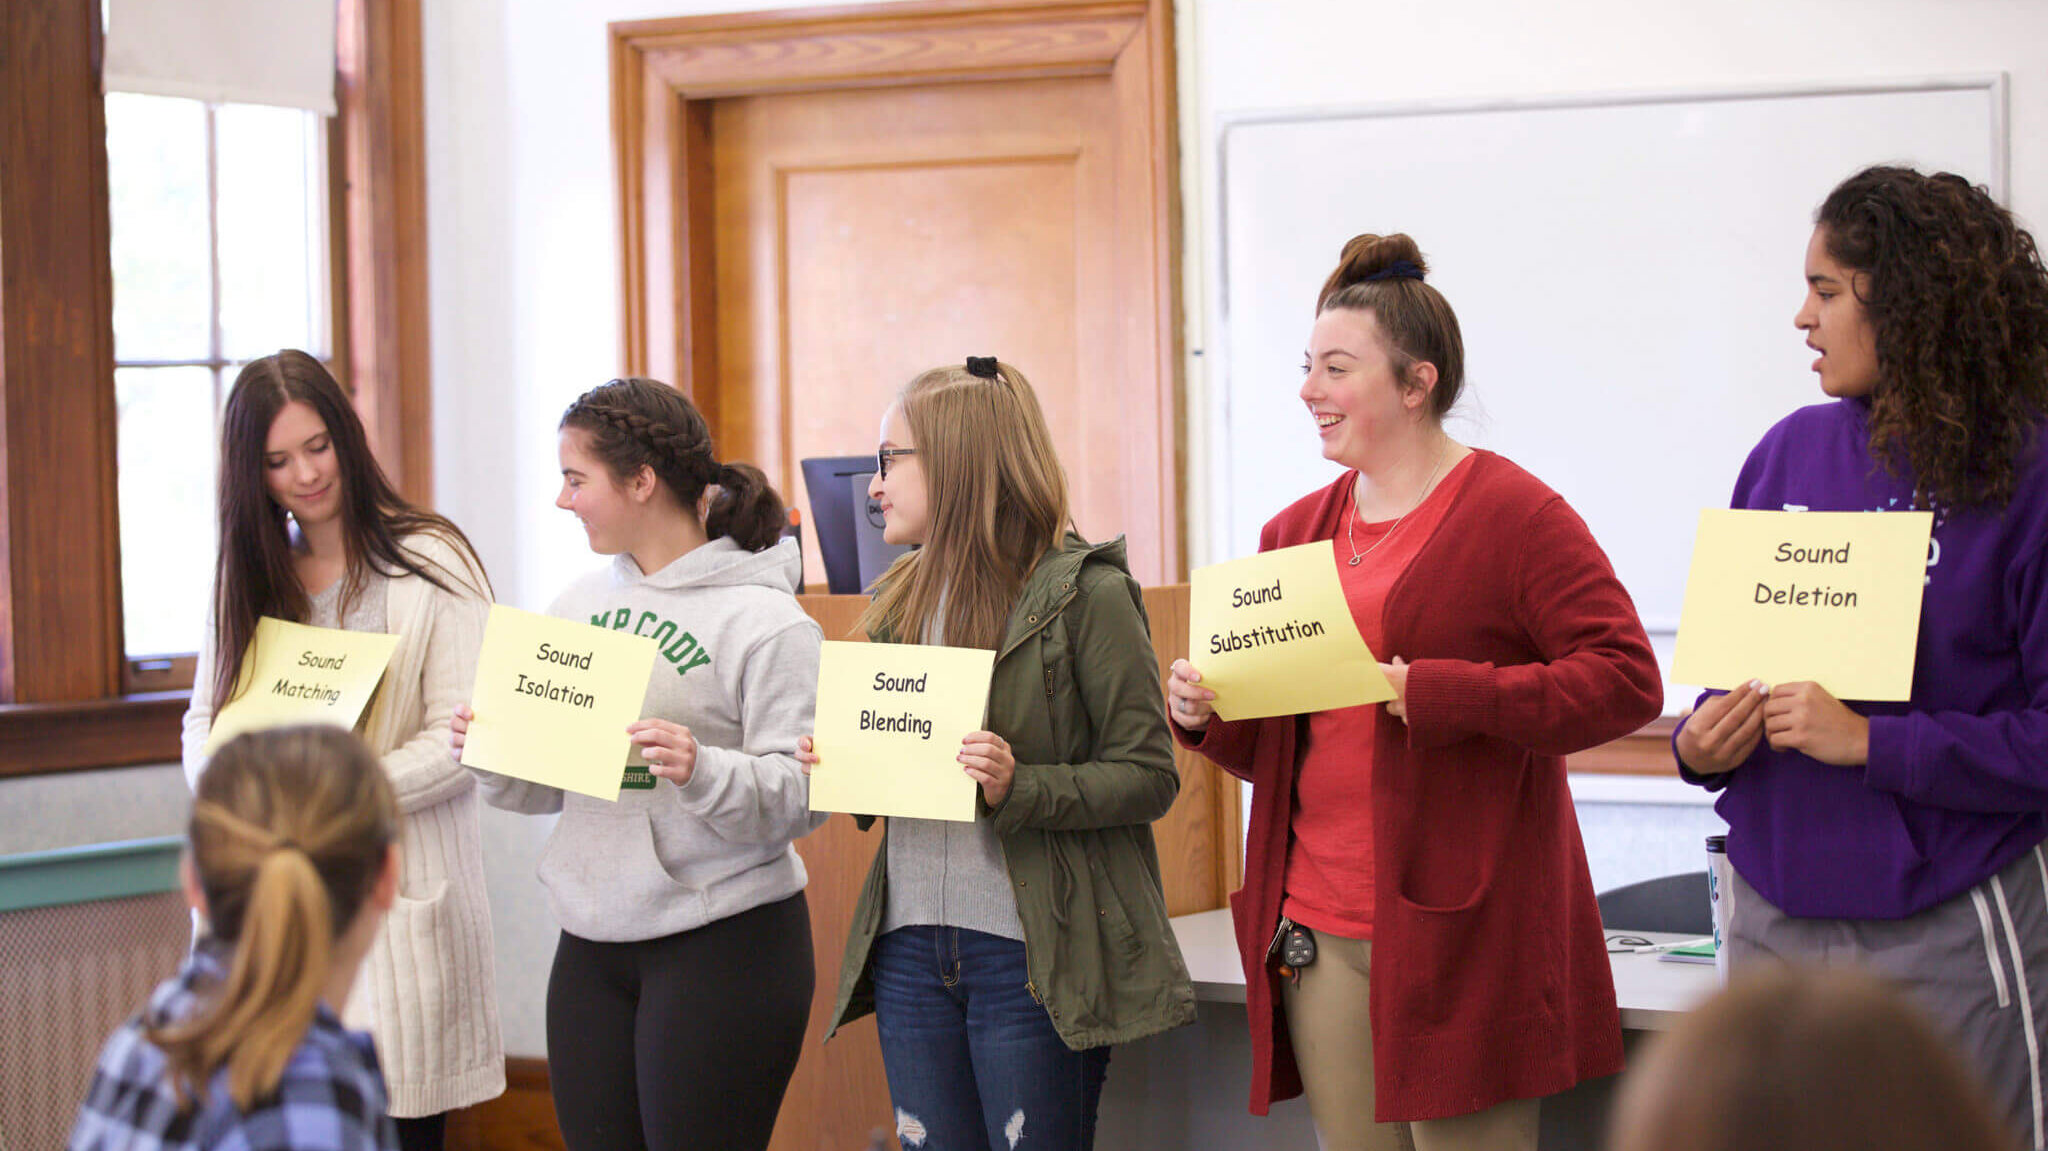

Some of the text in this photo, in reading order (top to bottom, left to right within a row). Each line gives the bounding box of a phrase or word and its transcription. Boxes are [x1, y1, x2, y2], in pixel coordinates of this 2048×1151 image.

[1774, 541, 1851, 565] Sound
[1232, 579, 1282, 608] Sound
[1754, 583, 1857, 608] Deletion
[634, 611, 711, 676] CODY
[1210, 619, 1325, 654] Substitution
[298, 651, 347, 671] Sound
[537, 643, 594, 671] Sound
[272, 679, 341, 706] Matching
[514, 674, 595, 710] Isolation
[873, 672, 927, 693] Sound
[859, 710, 932, 740] Blending
